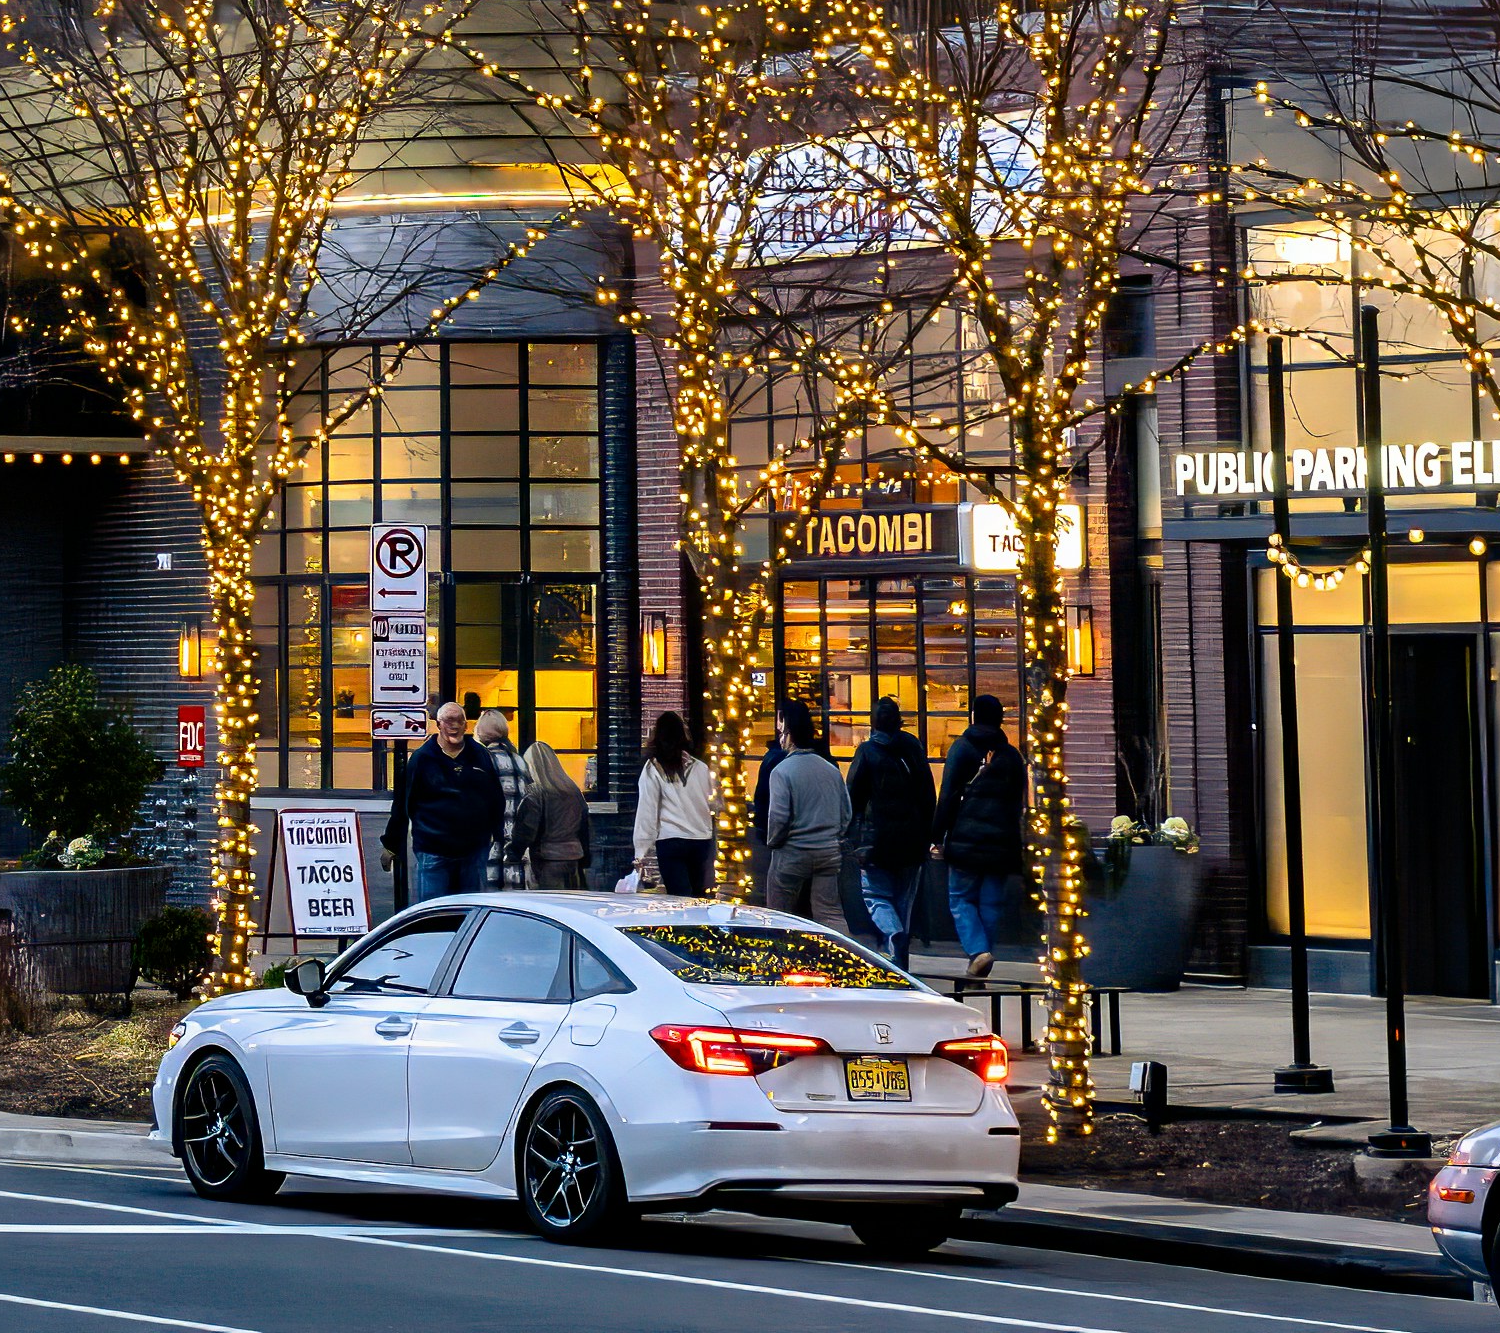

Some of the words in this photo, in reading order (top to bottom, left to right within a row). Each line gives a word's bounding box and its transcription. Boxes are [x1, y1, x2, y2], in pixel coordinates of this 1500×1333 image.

[805, 512, 932, 555] TACOMBI
[179, 721, 203, 751] FDC
[297, 865, 354, 885] TACOS
[308, 898, 355, 917] BEER
